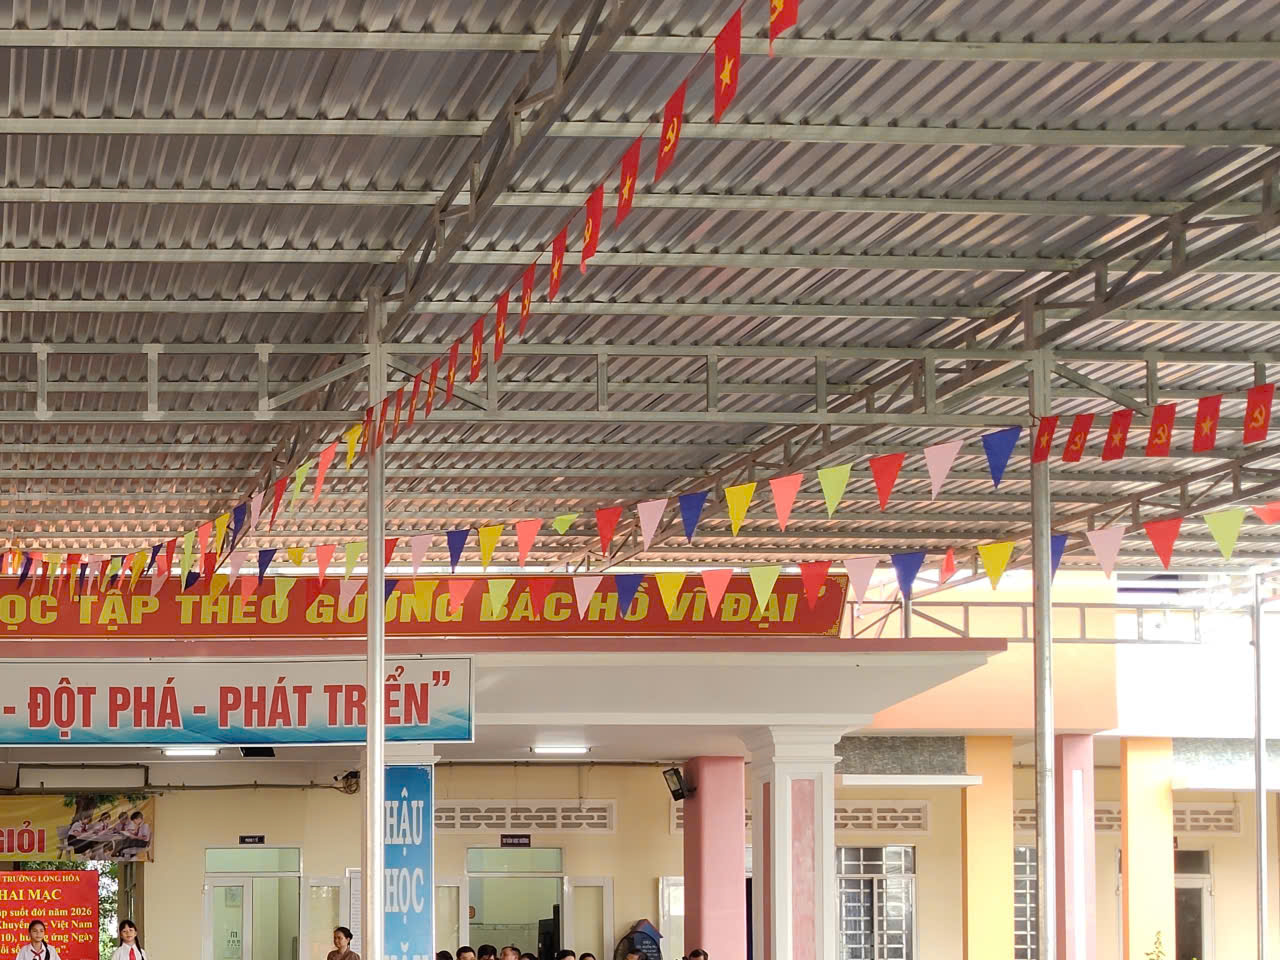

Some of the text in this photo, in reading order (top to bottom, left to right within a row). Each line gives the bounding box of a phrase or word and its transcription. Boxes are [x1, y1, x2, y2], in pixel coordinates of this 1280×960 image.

[74, 588, 160, 631] TẬP
[175, 594, 289, 624] THEO
[28, 677, 97, 738] ĐỘT
[108, 676, 182, 728] PHÁ
[219, 676, 313, 728] PHÁT
[323, 665, 451, 726] TRỂN”
[384, 787, 424, 857] HẬU
[28, 888, 62, 904] MẠC
[71, 907, 93, 917] 2026
[384, 867, 425, 925] HỌC
[71, 920, 93, 929] Nam
